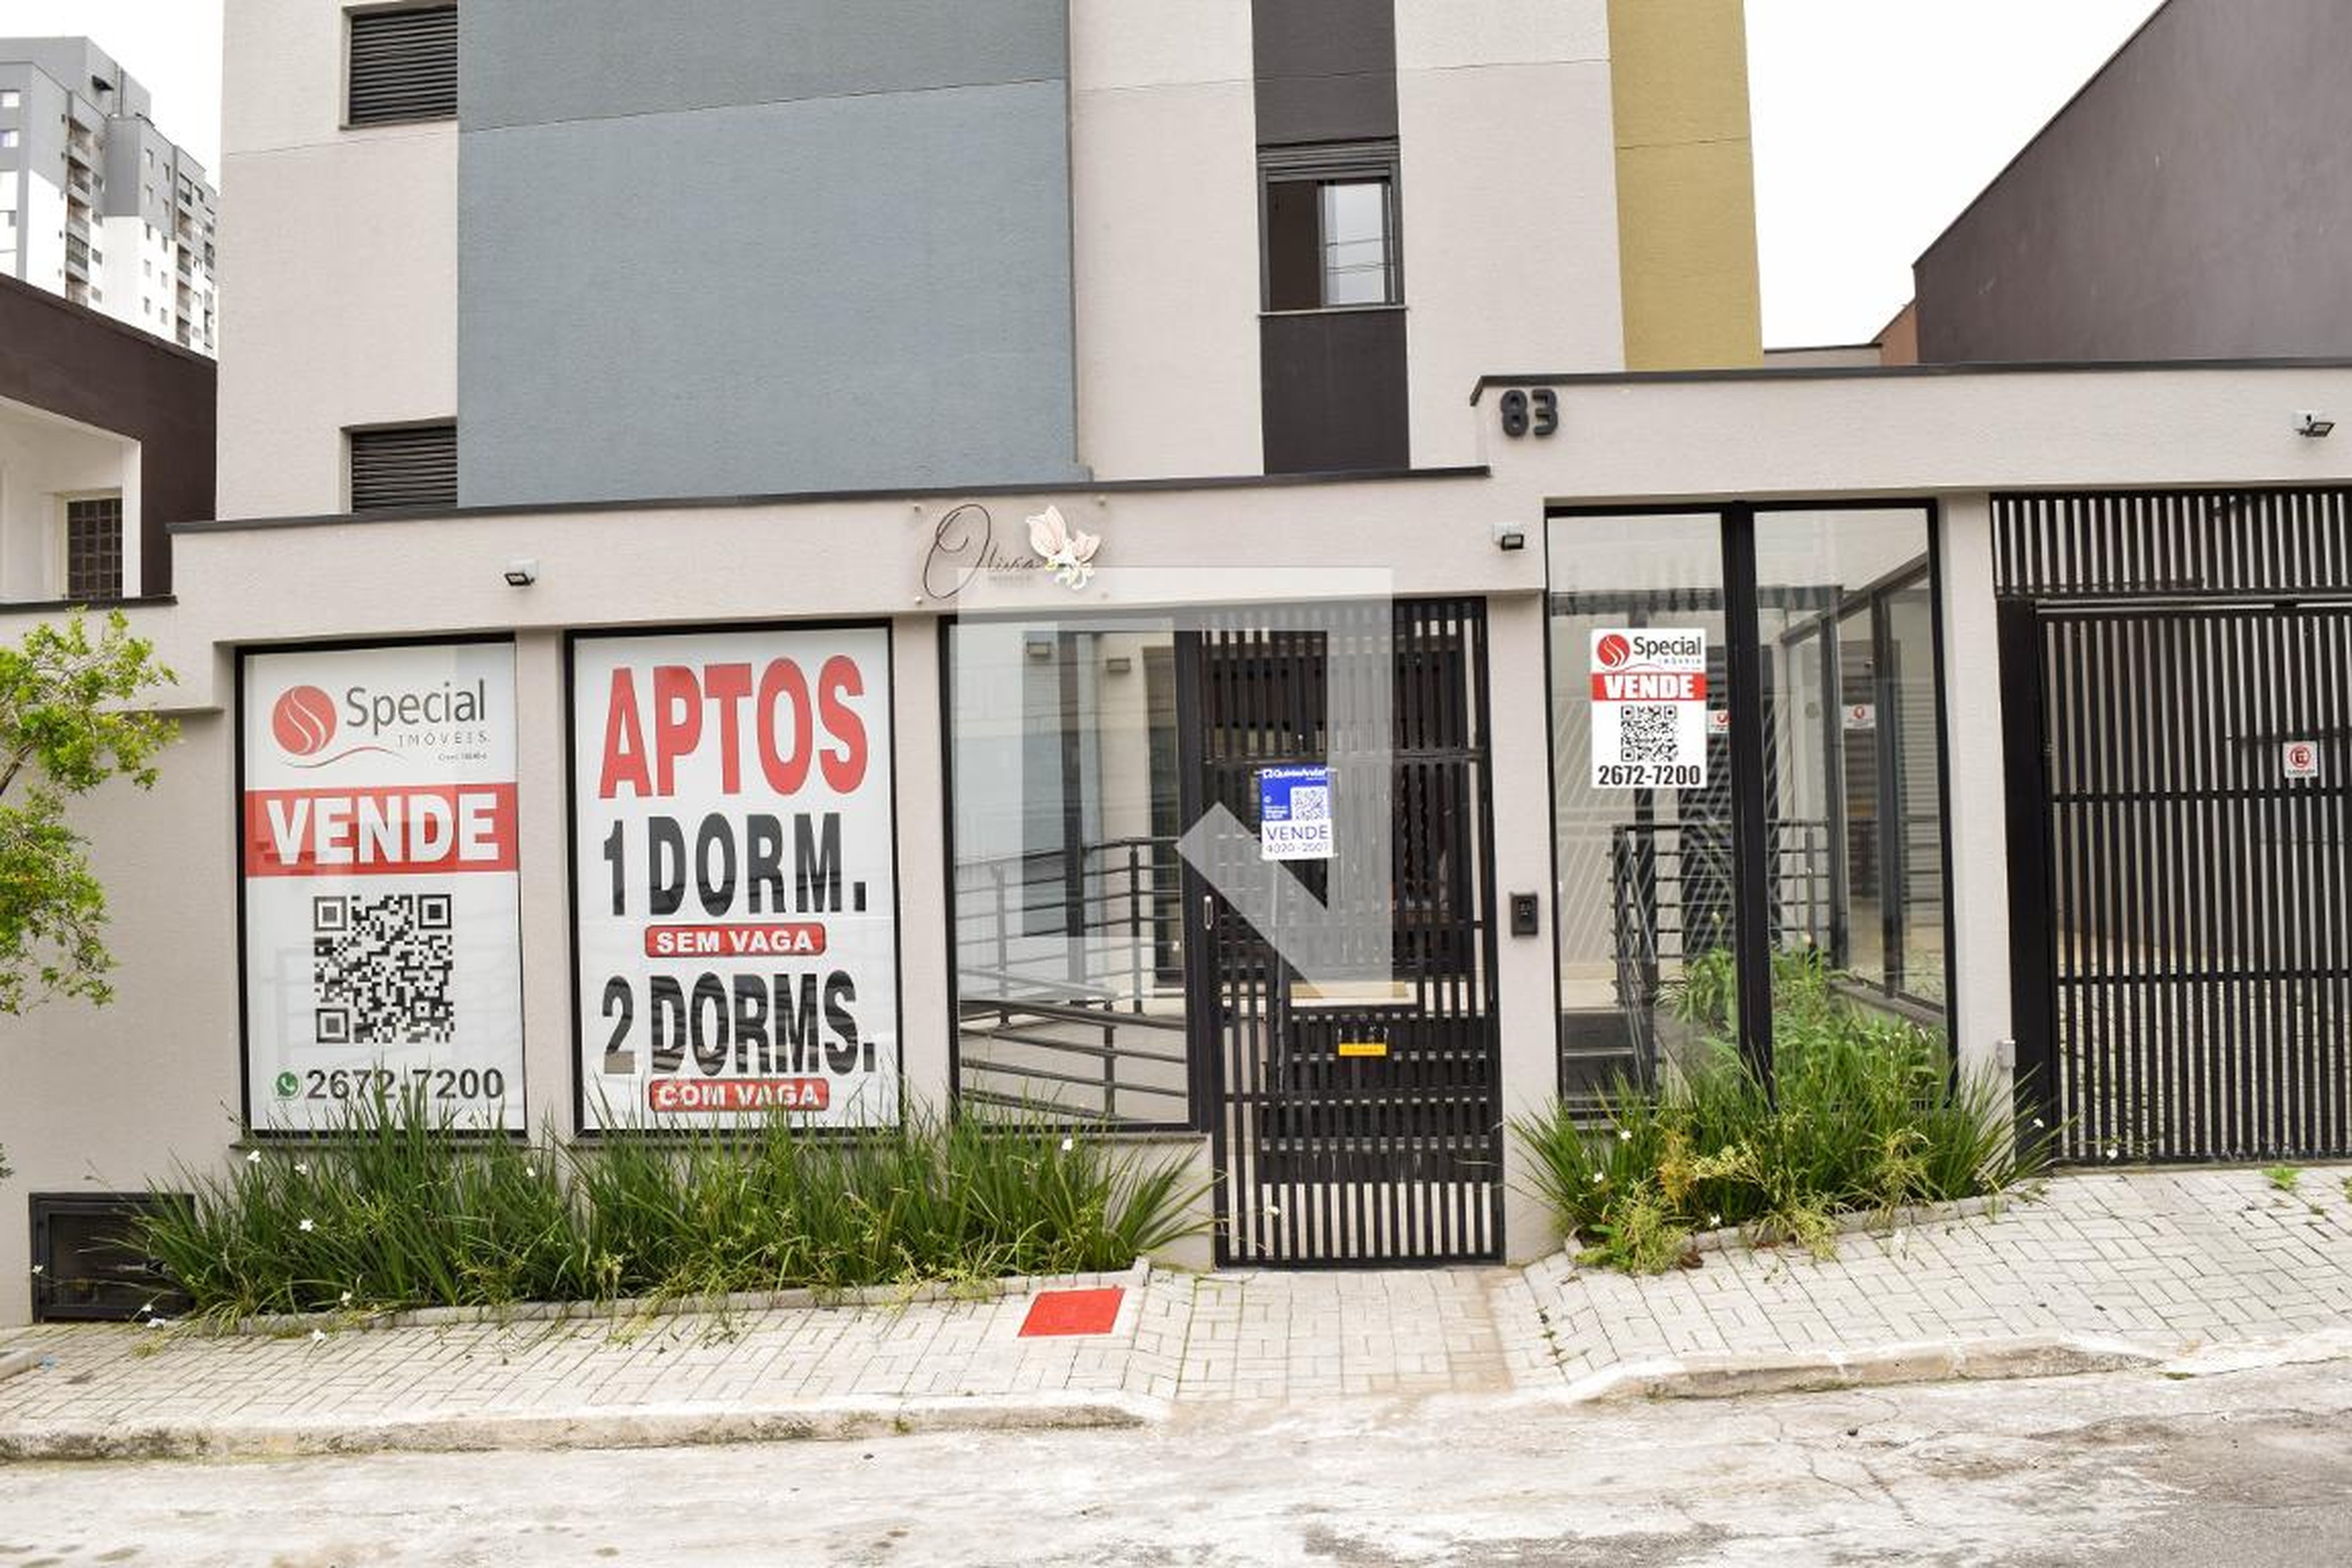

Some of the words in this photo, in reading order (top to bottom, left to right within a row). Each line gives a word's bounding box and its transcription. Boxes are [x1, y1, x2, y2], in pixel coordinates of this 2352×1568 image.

[1501, 389, 1558, 437] 83
[1633, 636, 1701, 659] Special
[1604, 674, 1694, 698] VENDE
[345, 679, 485, 735] Special
[600, 655, 868, 799] APTOS
[1598, 766, 1700, 785] 2672-7200
[266, 793, 499, 865] VENDE
[1265, 824, 1329, 840] VENDE
[604, 820, 625, 916] 1
[649, 812, 867, 916] DORM.
[657, 930, 720, 953] SEM
[727, 929, 815, 952] VAGA
[601, 975, 636, 1074] 2
[650, 970, 875, 1076] DORMS.
[657, 1084, 725, 1107] COM
[734, 1084, 820, 1106] VAGA
